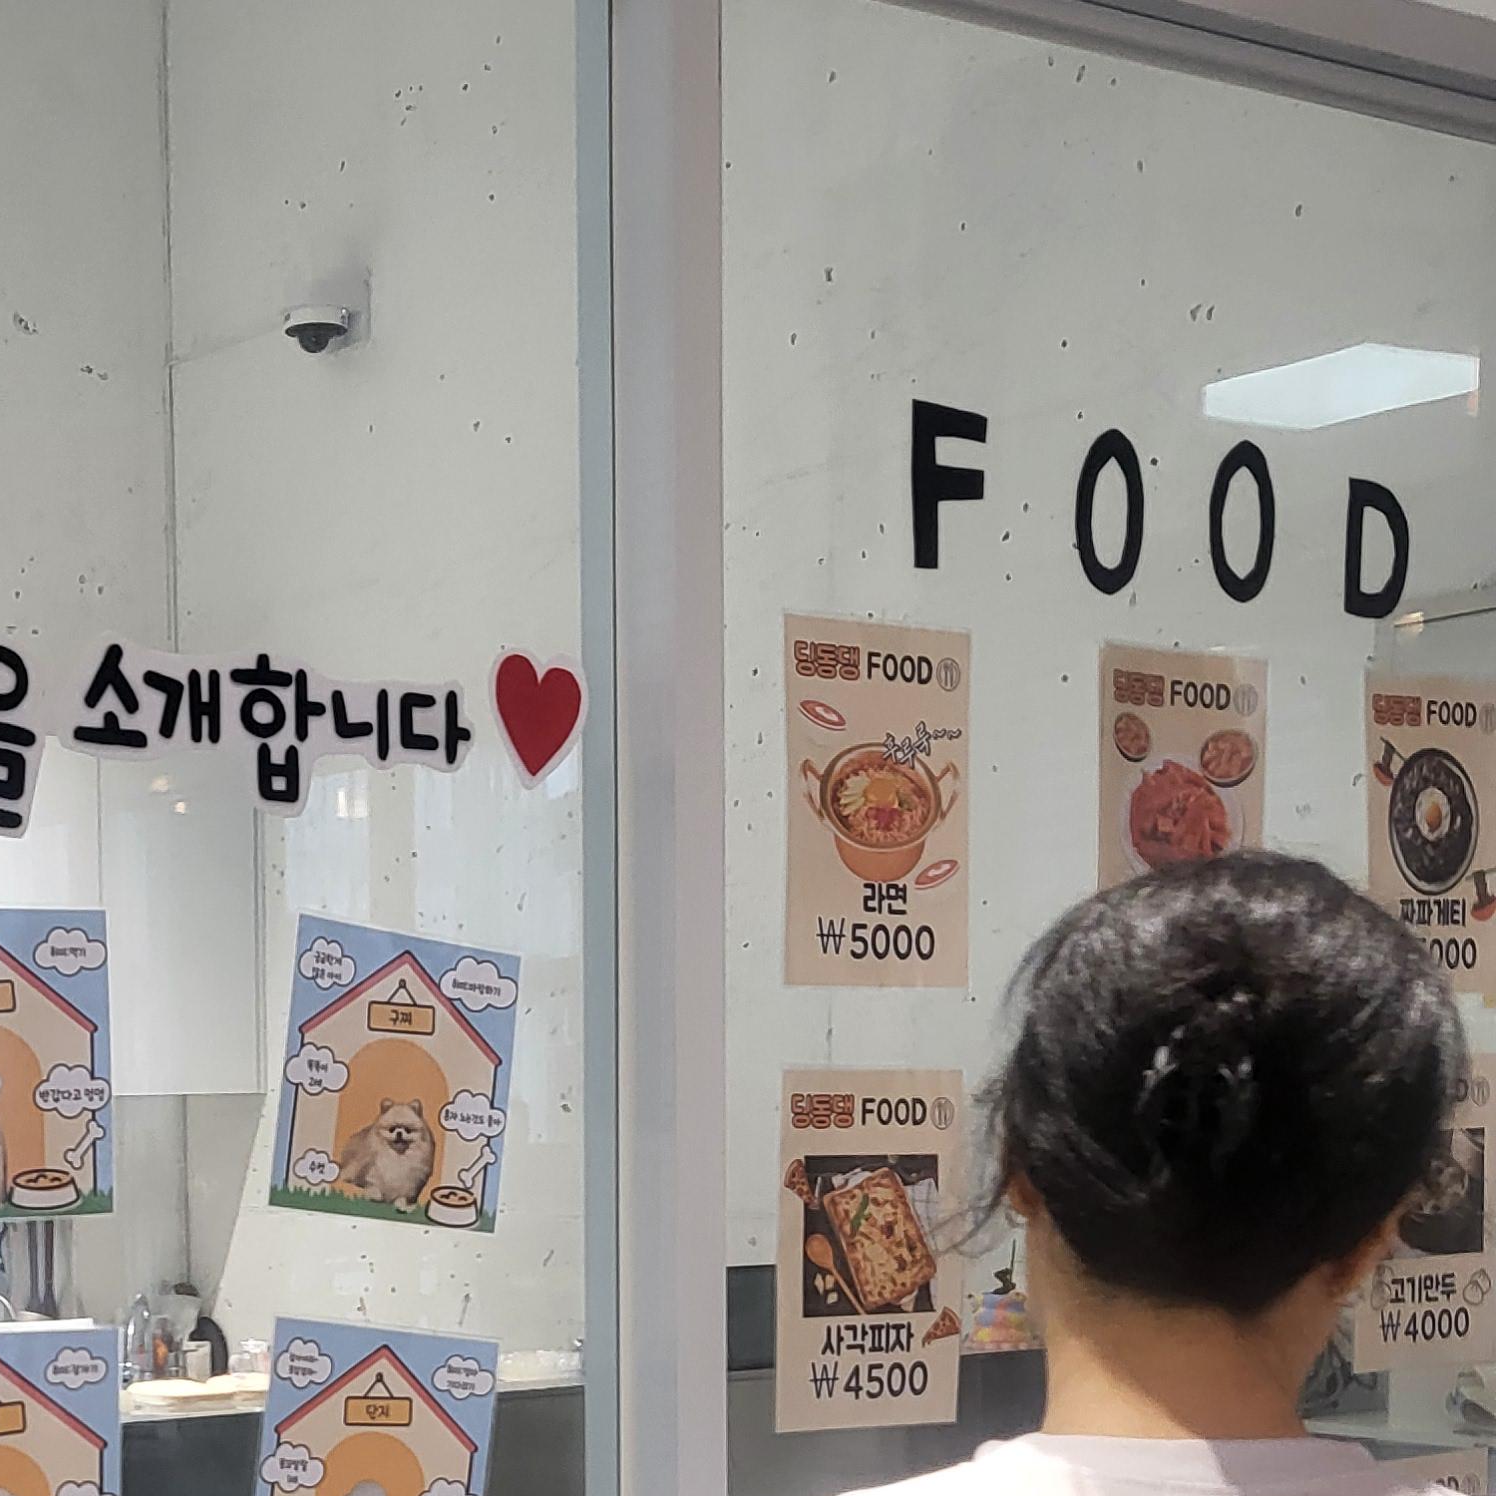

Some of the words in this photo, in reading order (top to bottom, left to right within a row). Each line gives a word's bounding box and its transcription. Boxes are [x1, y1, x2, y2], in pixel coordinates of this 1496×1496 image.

[911, 398, 1409, 618] FOOD
[794, 640, 860, 681] 딩동댕
[867, 651, 933, 685] FOOD
[1170, 679, 1232, 710] FOOD
[73, 643, 471, 803] 소개합니다
[1427, 700, 1477, 728] FOOD
[863, 883, 907, 915] 라면
[791, 1093, 854, 1130] 딩동댕
[861, 1097, 927, 1126] FOOD
[1389, 1273, 1457, 1305] 고기만두
[821, 1322, 914, 1357] 사각피자
[365, 1402, 391, 1419] 단지
